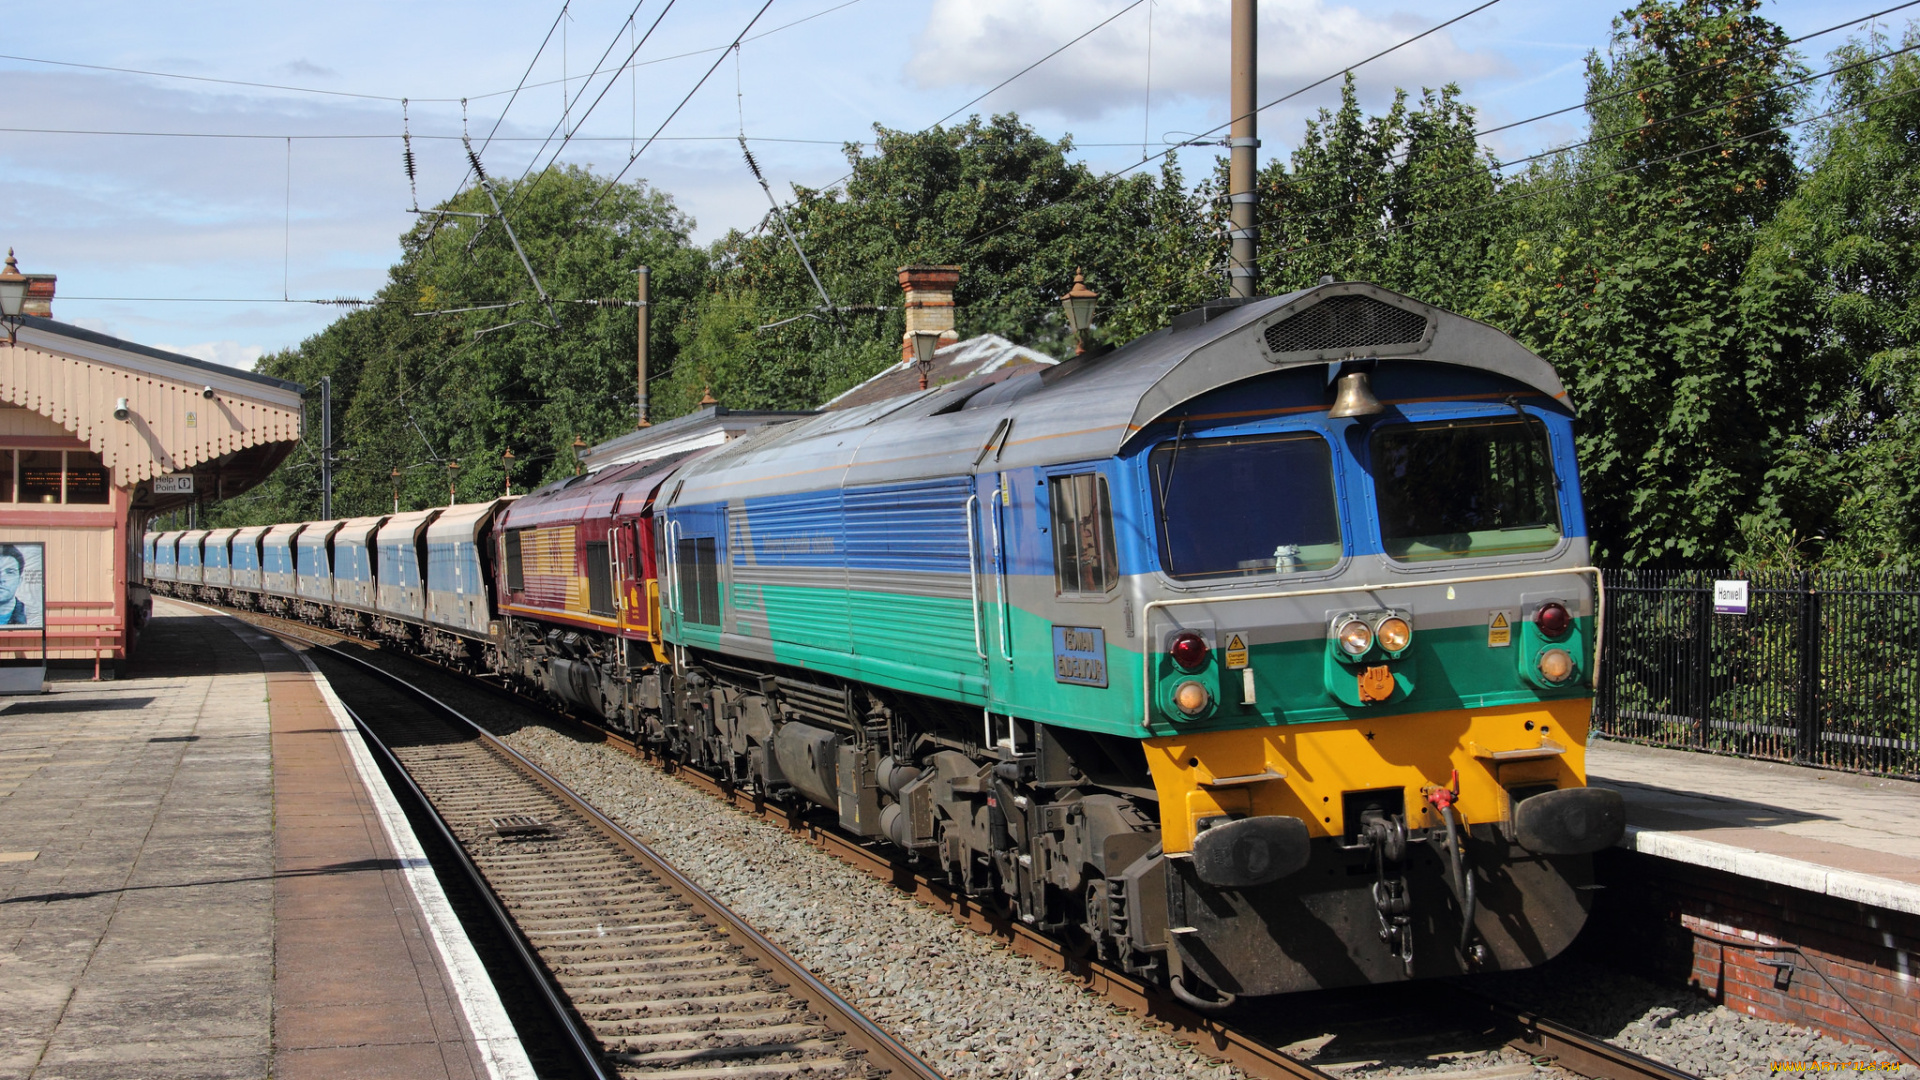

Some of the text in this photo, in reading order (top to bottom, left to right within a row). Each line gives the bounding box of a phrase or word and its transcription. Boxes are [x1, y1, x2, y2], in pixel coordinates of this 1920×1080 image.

[156, 476, 174, 484] Help
[156, 484, 176, 492] Point
[1718, 587, 1743, 601] Hanwell
